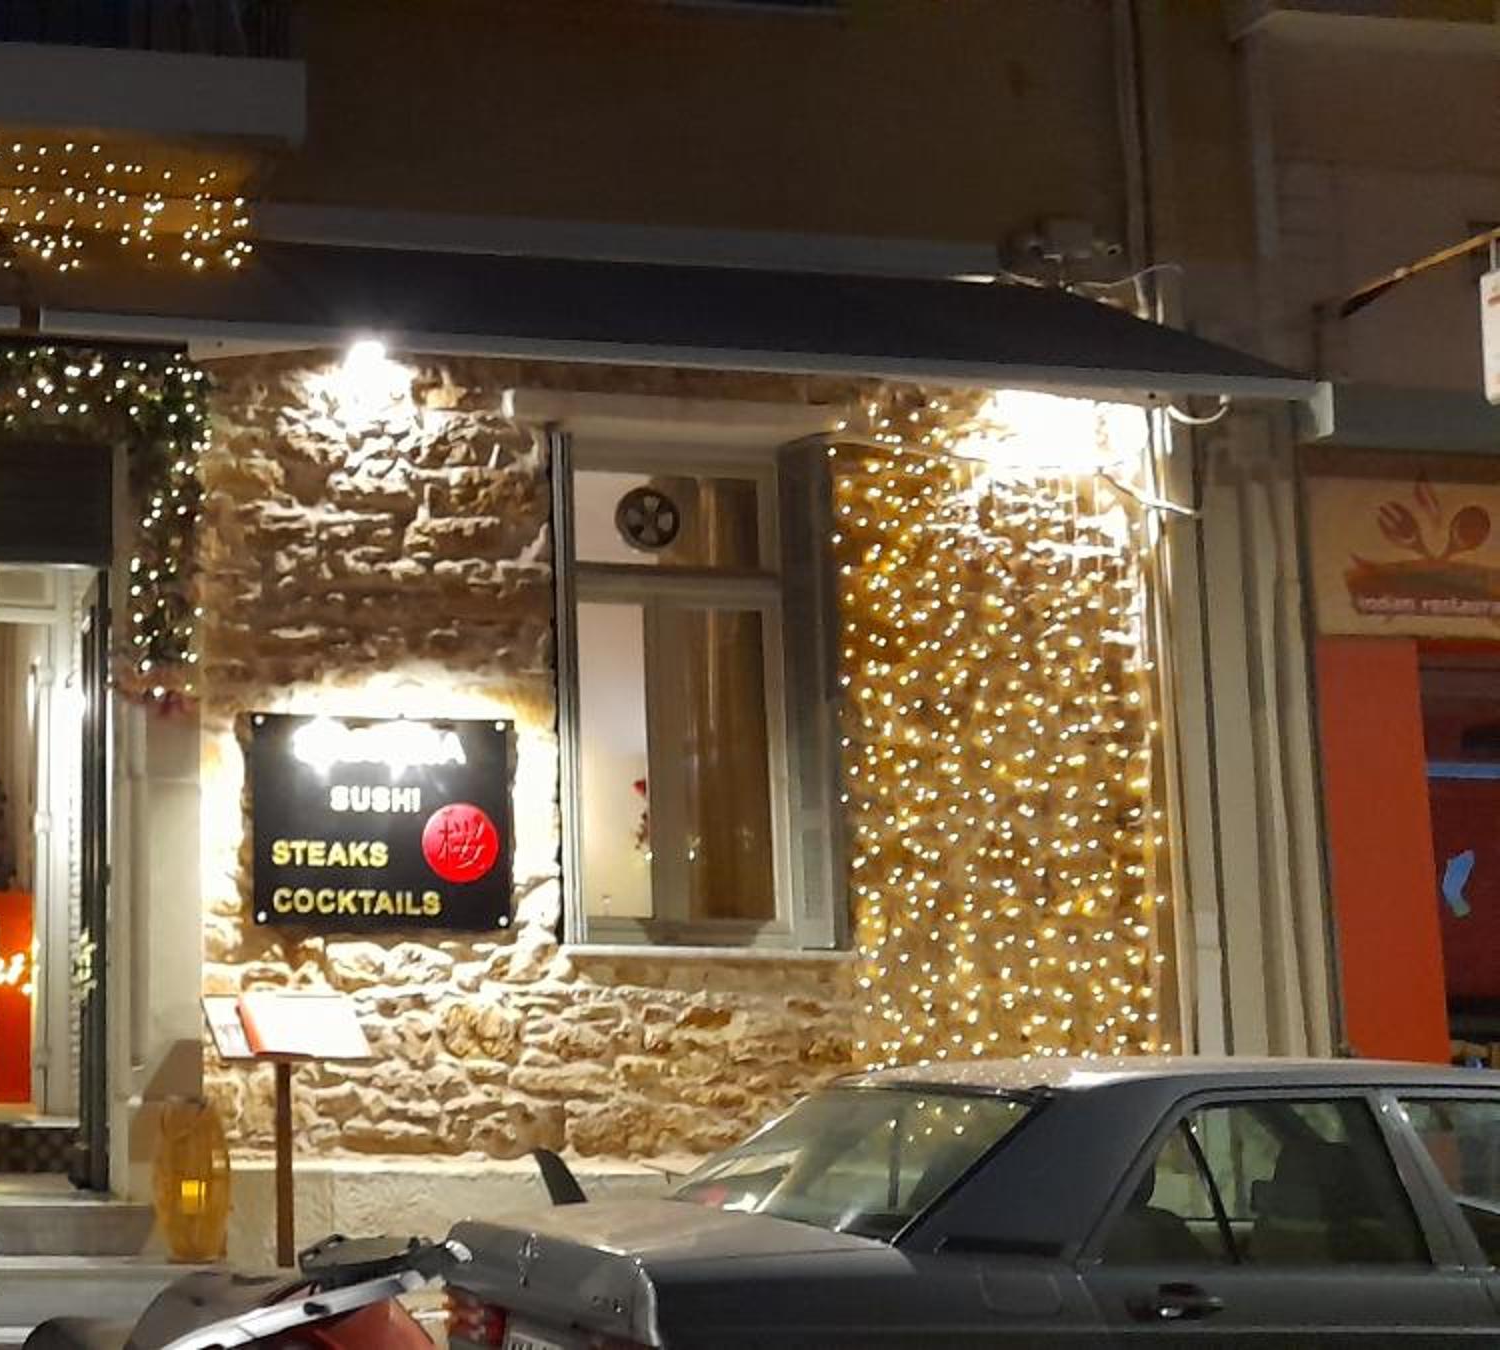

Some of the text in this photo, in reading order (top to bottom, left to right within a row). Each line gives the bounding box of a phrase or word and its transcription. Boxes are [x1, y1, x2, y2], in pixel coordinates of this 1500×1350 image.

[329, 785, 421, 812] SUSHI
[271, 839, 389, 868] STEAKS
[273, 888, 442, 915] COCKTAILS
